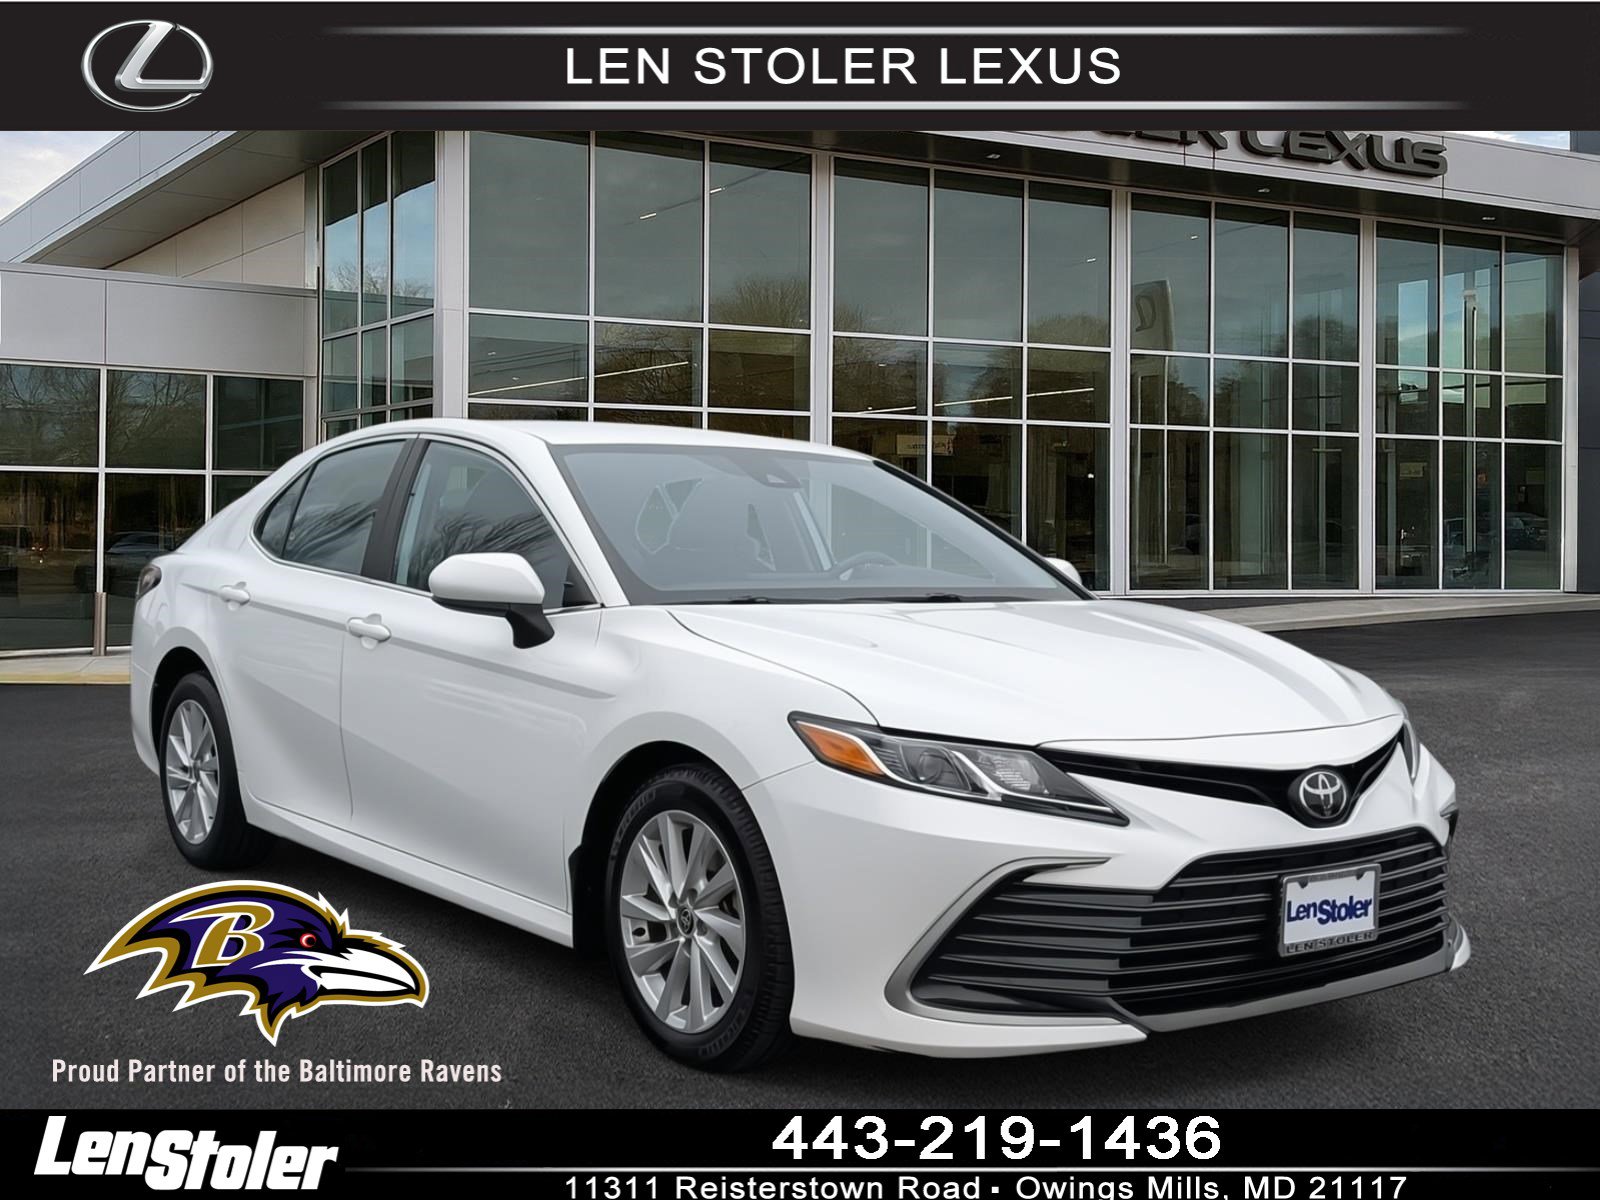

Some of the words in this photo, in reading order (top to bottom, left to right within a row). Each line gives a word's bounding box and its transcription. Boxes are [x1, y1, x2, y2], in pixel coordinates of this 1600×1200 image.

[1240, 130, 1448, 178] LEXUS
[1286, 895, 1373, 926] LenStoler
[1286, 941, 1314, 954] LEN
[1319, 931, 1373, 949] STOLER
